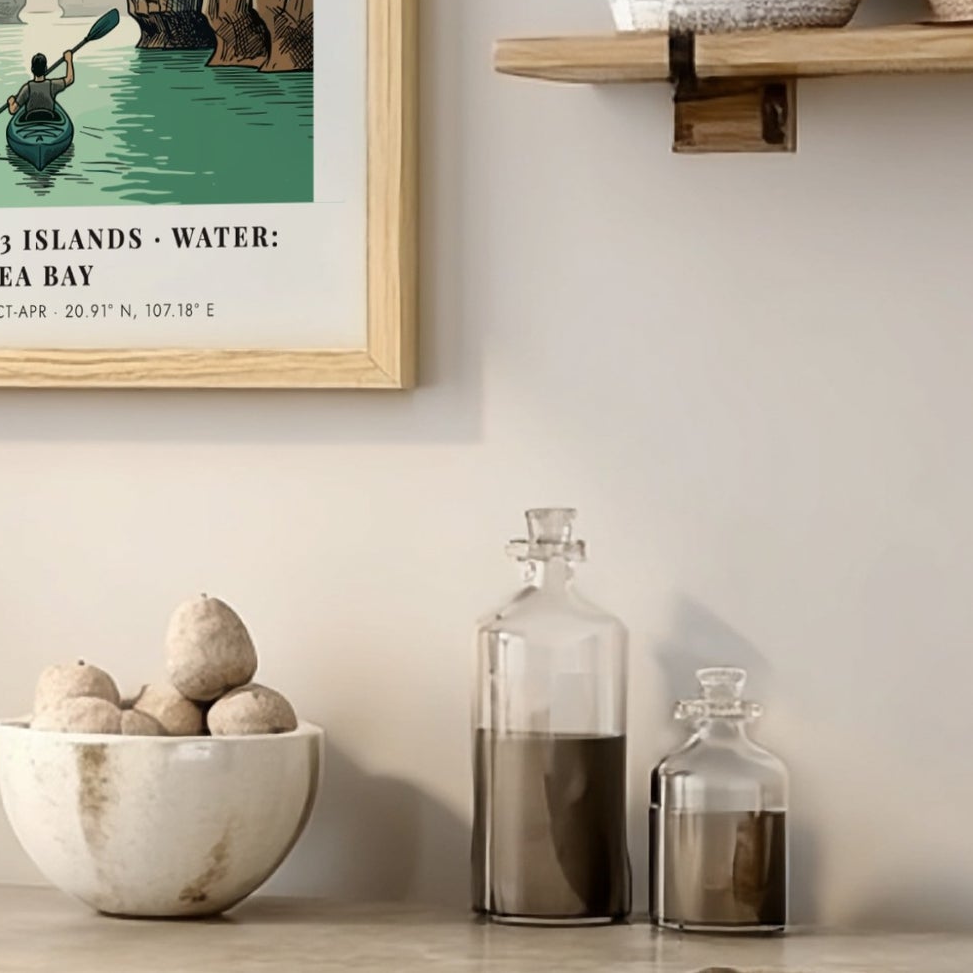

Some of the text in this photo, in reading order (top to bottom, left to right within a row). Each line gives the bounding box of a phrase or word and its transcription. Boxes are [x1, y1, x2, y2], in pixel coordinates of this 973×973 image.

[23, 227, 142, 251] ISLANDS
[171, 226, 278, 249] WATER:
[44, 265, 94, 287] BAY
[65, 303, 113, 319] 20.91°
[120, 304, 137, 320] N,
[145, 302, 200, 318] 107.18°
[206, 302, 214, 318] E
